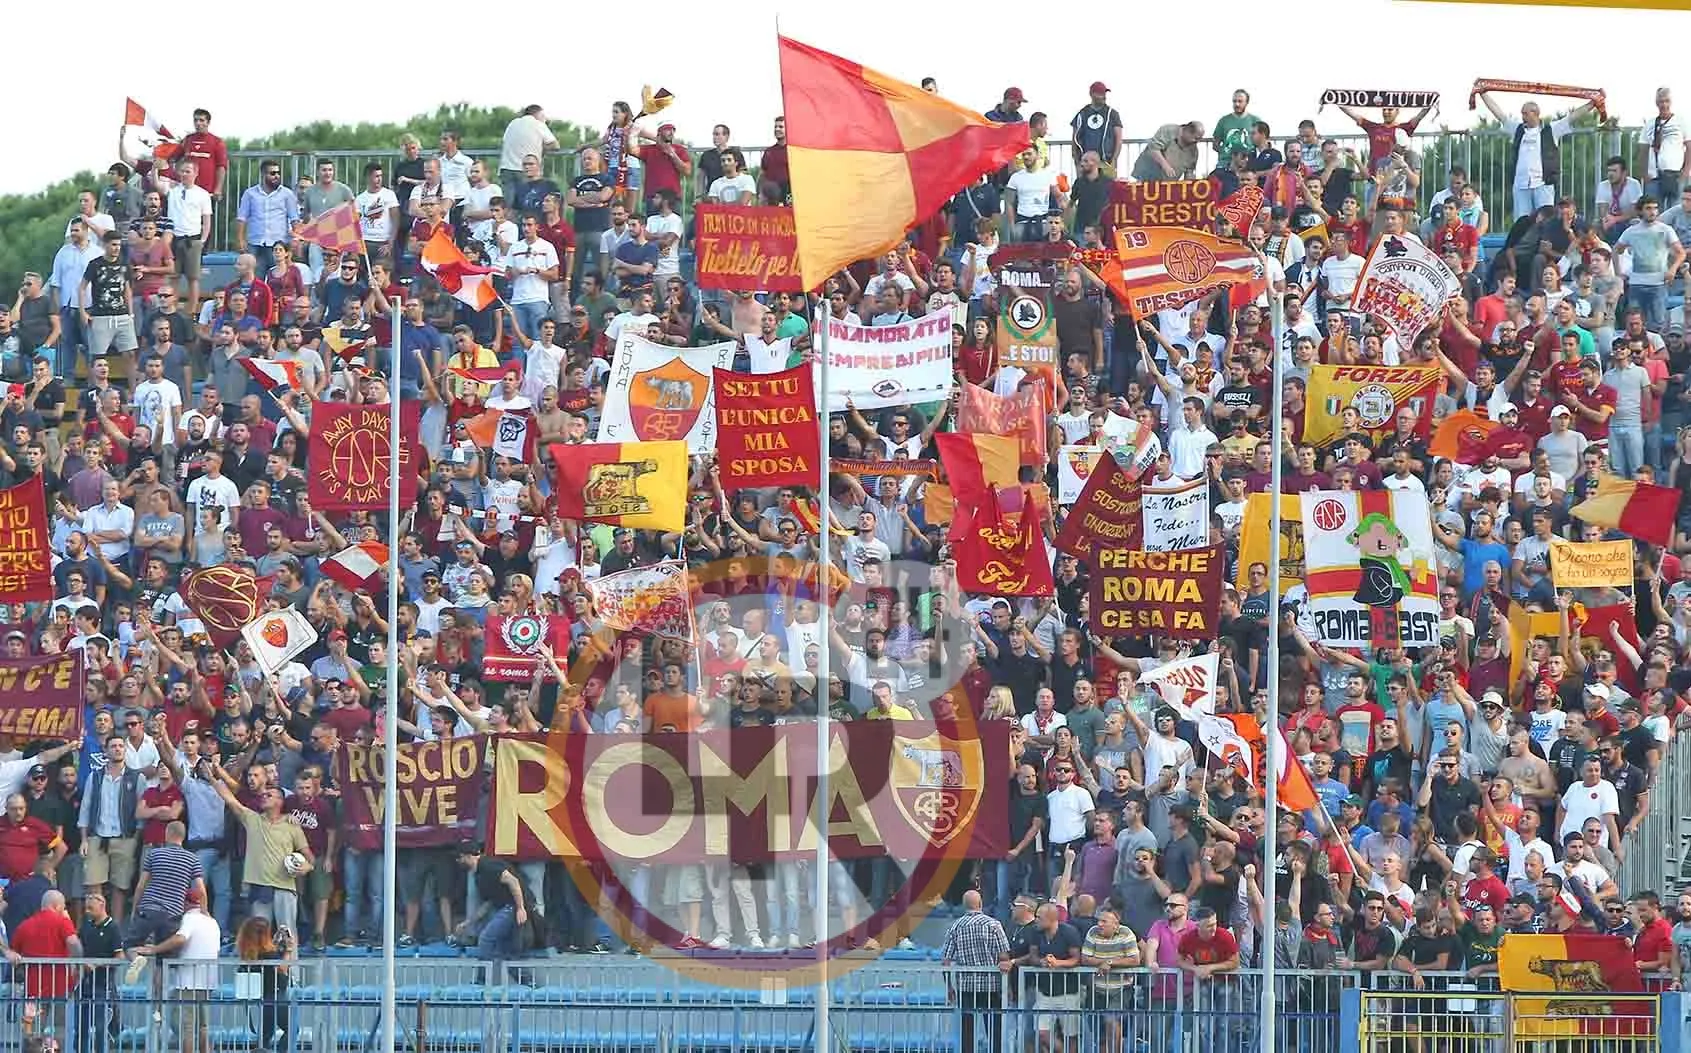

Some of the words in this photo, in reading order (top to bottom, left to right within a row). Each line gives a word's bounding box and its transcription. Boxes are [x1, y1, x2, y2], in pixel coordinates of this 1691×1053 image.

[1324, 90, 1368, 105] ODIO
[1127, 180, 1211, 201] TUTTO
[1114, 203, 1135, 223] IL
[1142, 201, 1216, 223] RESTO
[1123, 231, 1149, 249] 19
[1000, 270, 1051, 287] ROMA...
[1333, 367, 1423, 384] FORZA
[723, 380, 760, 396] SEI
[766, 378, 799, 395] TU
[720, 405, 811, 426] L'UNICA
[322, 413, 353, 447] AWAY
[362, 410, 391, 432] DAYS
[744, 431, 789, 451] MIA
[731, 456, 808, 476] SPOSA
[320, 469, 341, 494] IT'S
[343, 488, 352, 502] A
[356, 484, 382, 503] WAY
[1145, 497, 1158, 510] La
[1162, 492, 1207, 511] Nostra
[1313, 500, 1346, 531] ASR
[1099, 549, 1217, 572] PERCHE'
[1556, 545, 1602, 563] Dicono
[1103, 576, 1203, 603] ROMA
[1100, 609, 1133, 628] CE
[1137, 609, 1165, 628] SA
[1174, 611, 1206, 630] FA
[1314, 609, 1371, 641] ROMA
[347, 739, 478, 784] ROSCIO
[493, 732, 883, 858] ROMA
[362, 785, 458, 828] VIVE
